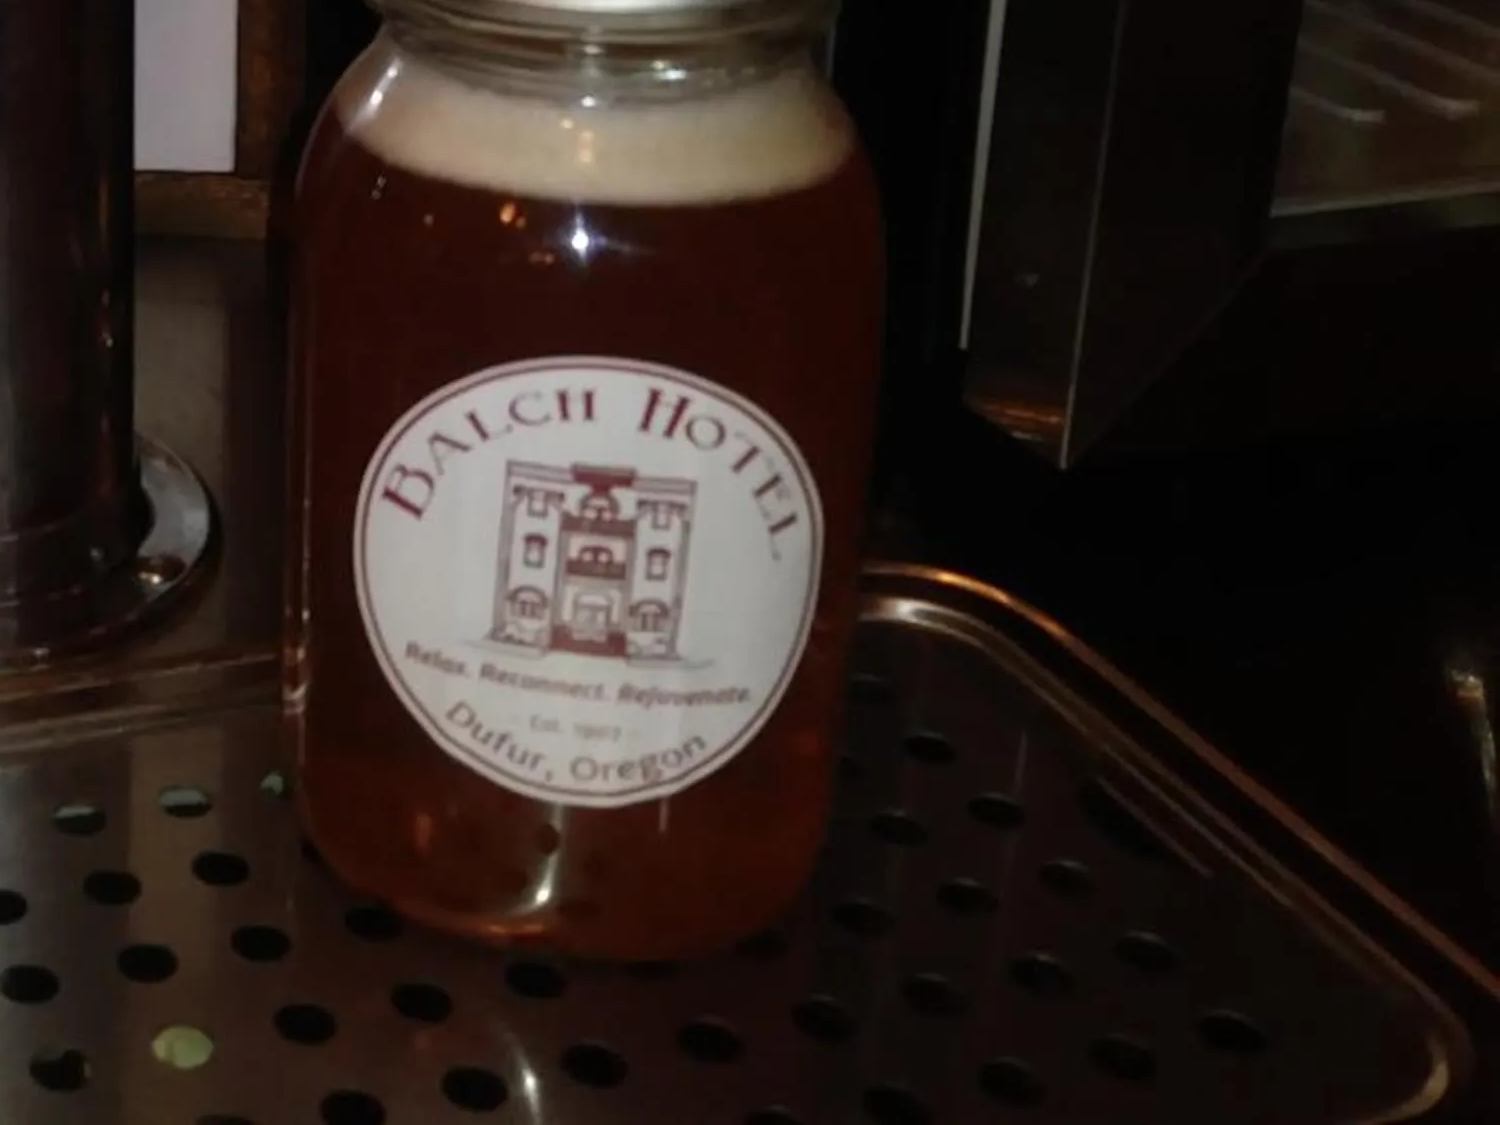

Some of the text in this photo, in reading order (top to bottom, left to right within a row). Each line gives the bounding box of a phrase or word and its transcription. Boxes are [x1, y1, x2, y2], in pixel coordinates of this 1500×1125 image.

[381, 387, 799, 562] BALCH HOTEL
[444, 699, 707, 784] Dufur, Oregon
